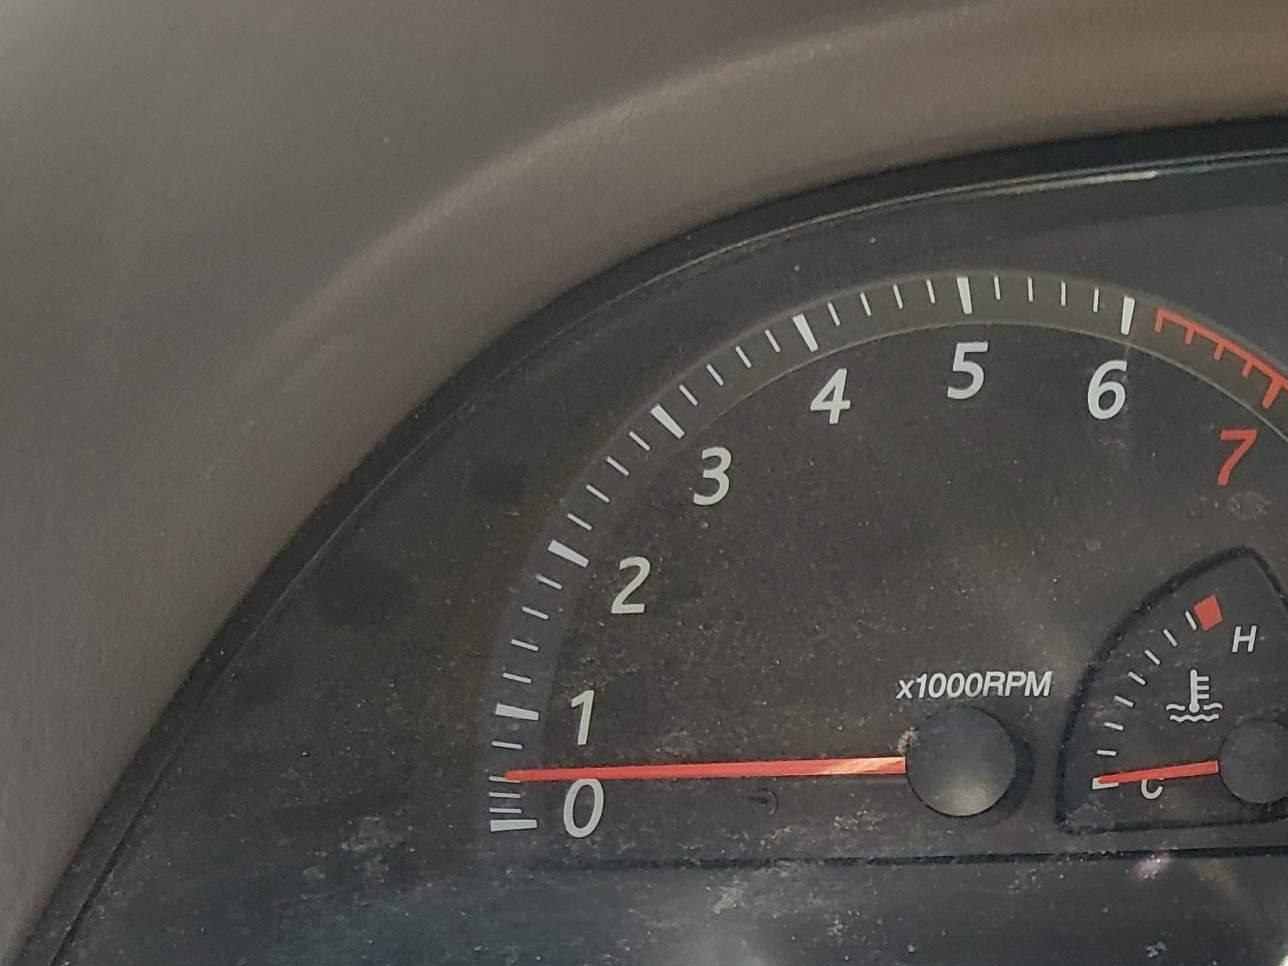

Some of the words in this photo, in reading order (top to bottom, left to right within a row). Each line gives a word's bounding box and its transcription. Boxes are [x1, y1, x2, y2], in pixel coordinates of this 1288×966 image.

[810, 368, 851, 424] 4
[947, 340, 988, 399] 5
[1087, 360, 1127, 419] 6
[693, 447, 731, 506] 3
[1216, 429, 1257, 486] 7
[611, 556, 650, 614] 2
[1232, 625, 1257, 652] H
[896, 671, 1052, 699] x1000RPM
[570, 690, 594, 745] 1
[563, 778, 604, 838] 0
[1141, 776, 1165, 800] C
